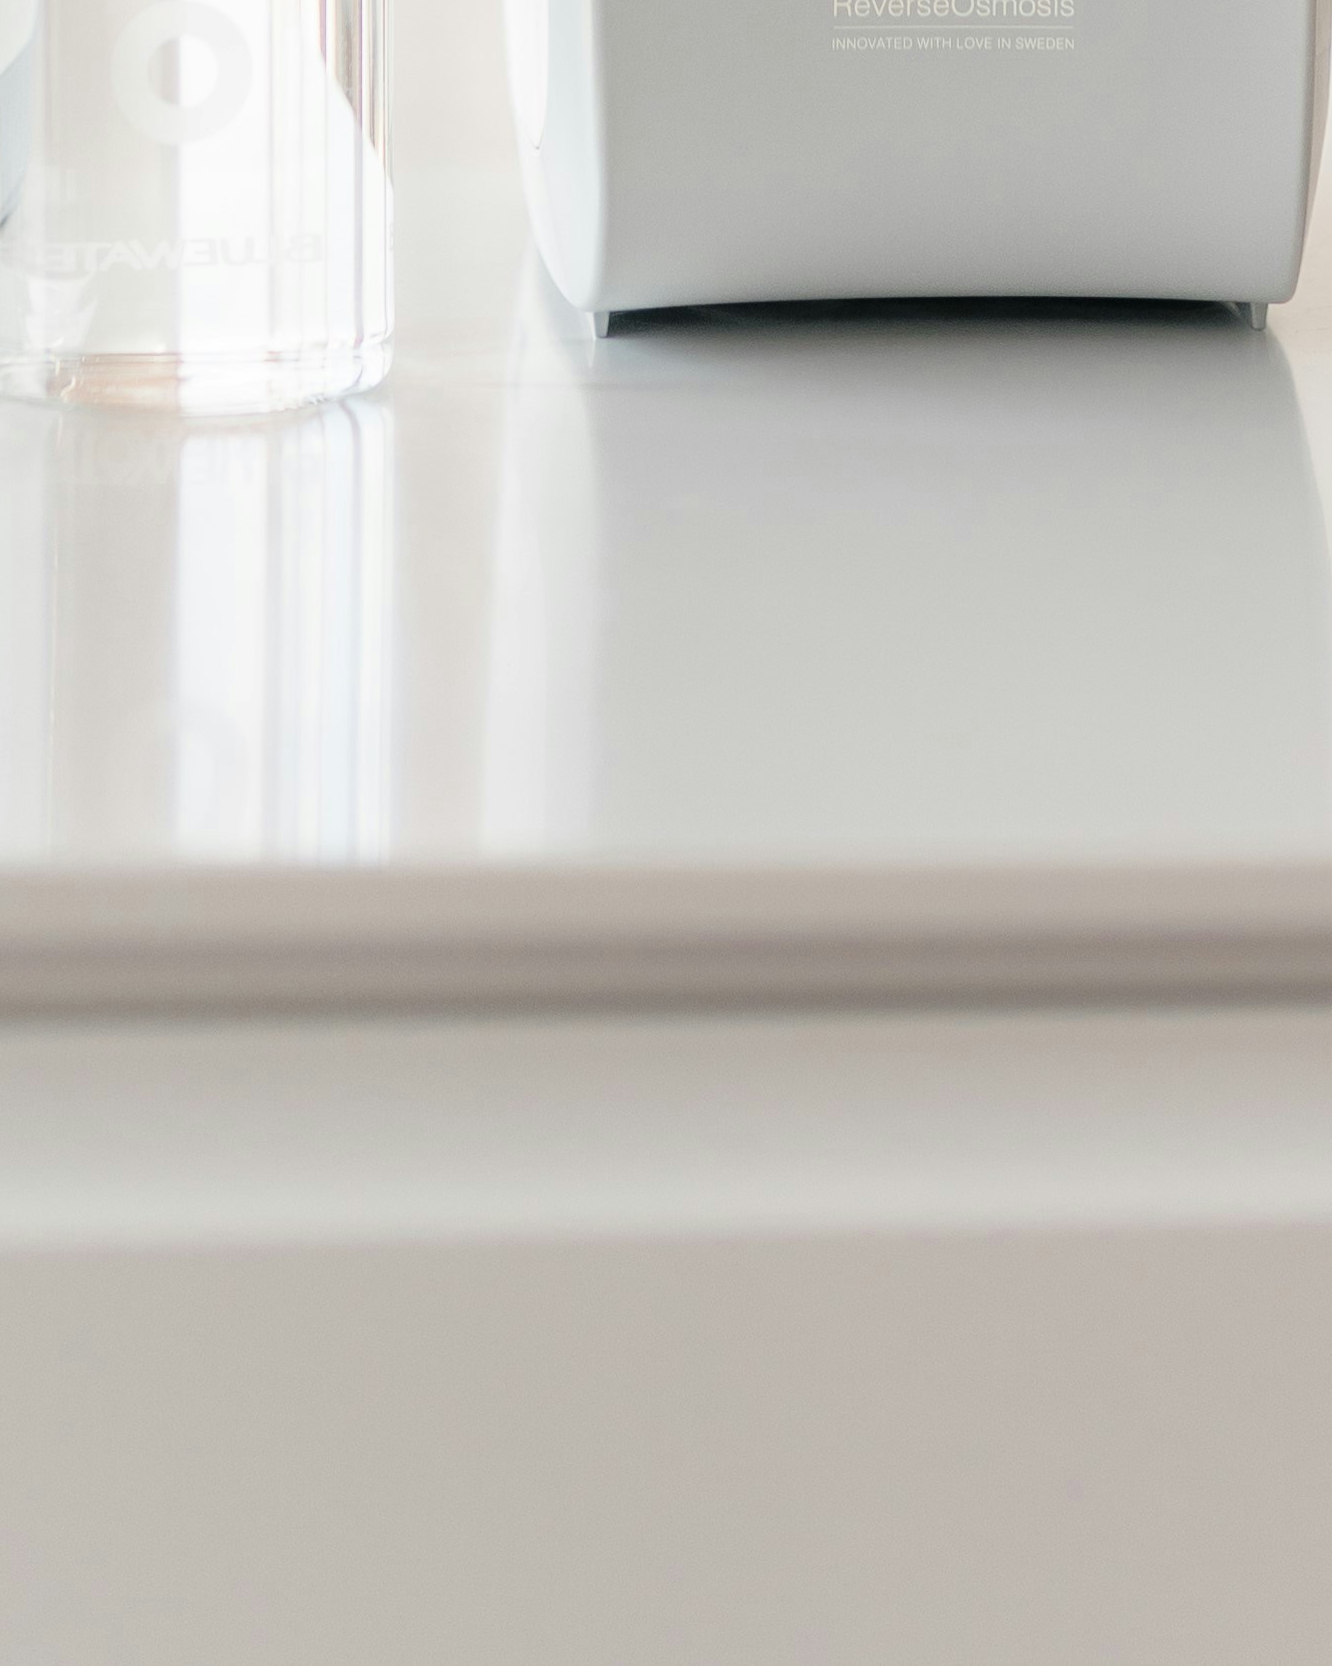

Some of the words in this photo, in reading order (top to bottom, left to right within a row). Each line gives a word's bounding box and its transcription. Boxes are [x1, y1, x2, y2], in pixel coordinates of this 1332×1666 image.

[831, 37, 913, 50] INNOVATED
[916, 37, 952, 50] WITH
[956, 37, 993, 50] LOVE
[997, 37, 1011, 50] IN
[1015, 37, 1076, 50] SWEDEN
